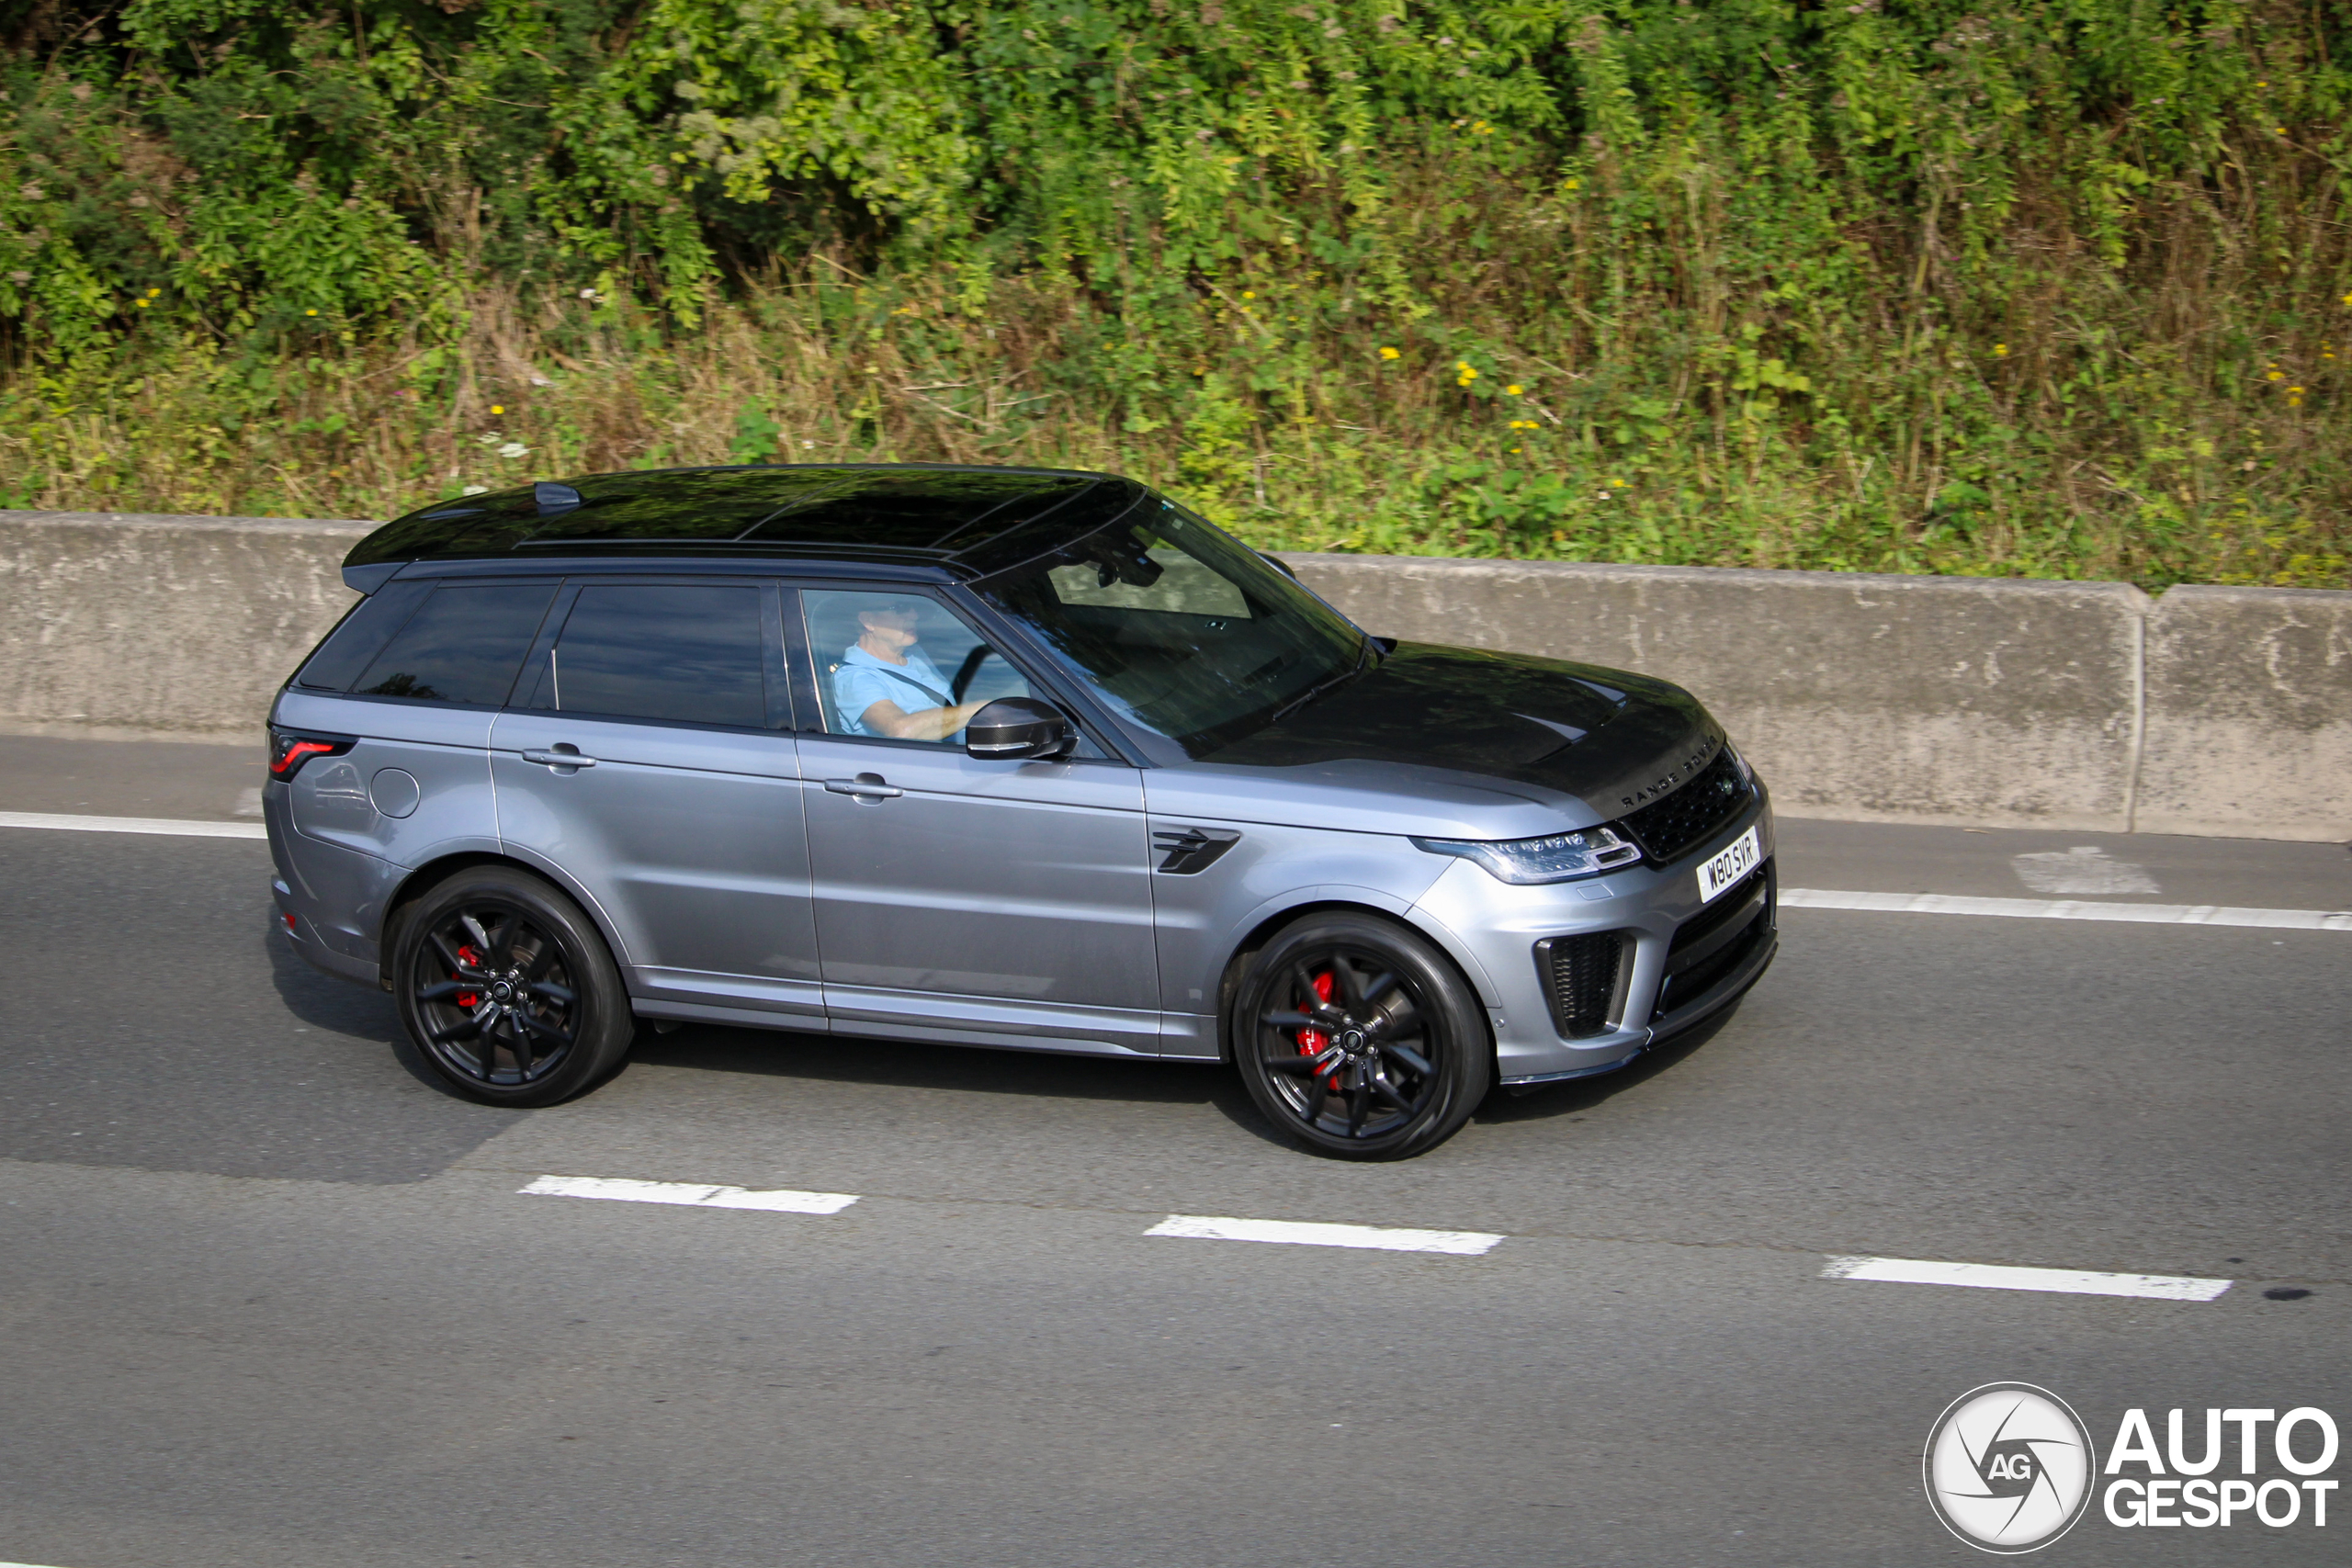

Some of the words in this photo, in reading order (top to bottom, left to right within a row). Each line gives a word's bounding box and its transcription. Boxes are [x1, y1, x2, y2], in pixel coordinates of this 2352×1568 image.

[1621, 773, 1679, 808] RANGE
[1682, 735, 1718, 773] ROVER
[1707, 852, 1733, 891] W80
[1733, 835, 1754, 873] SVR
